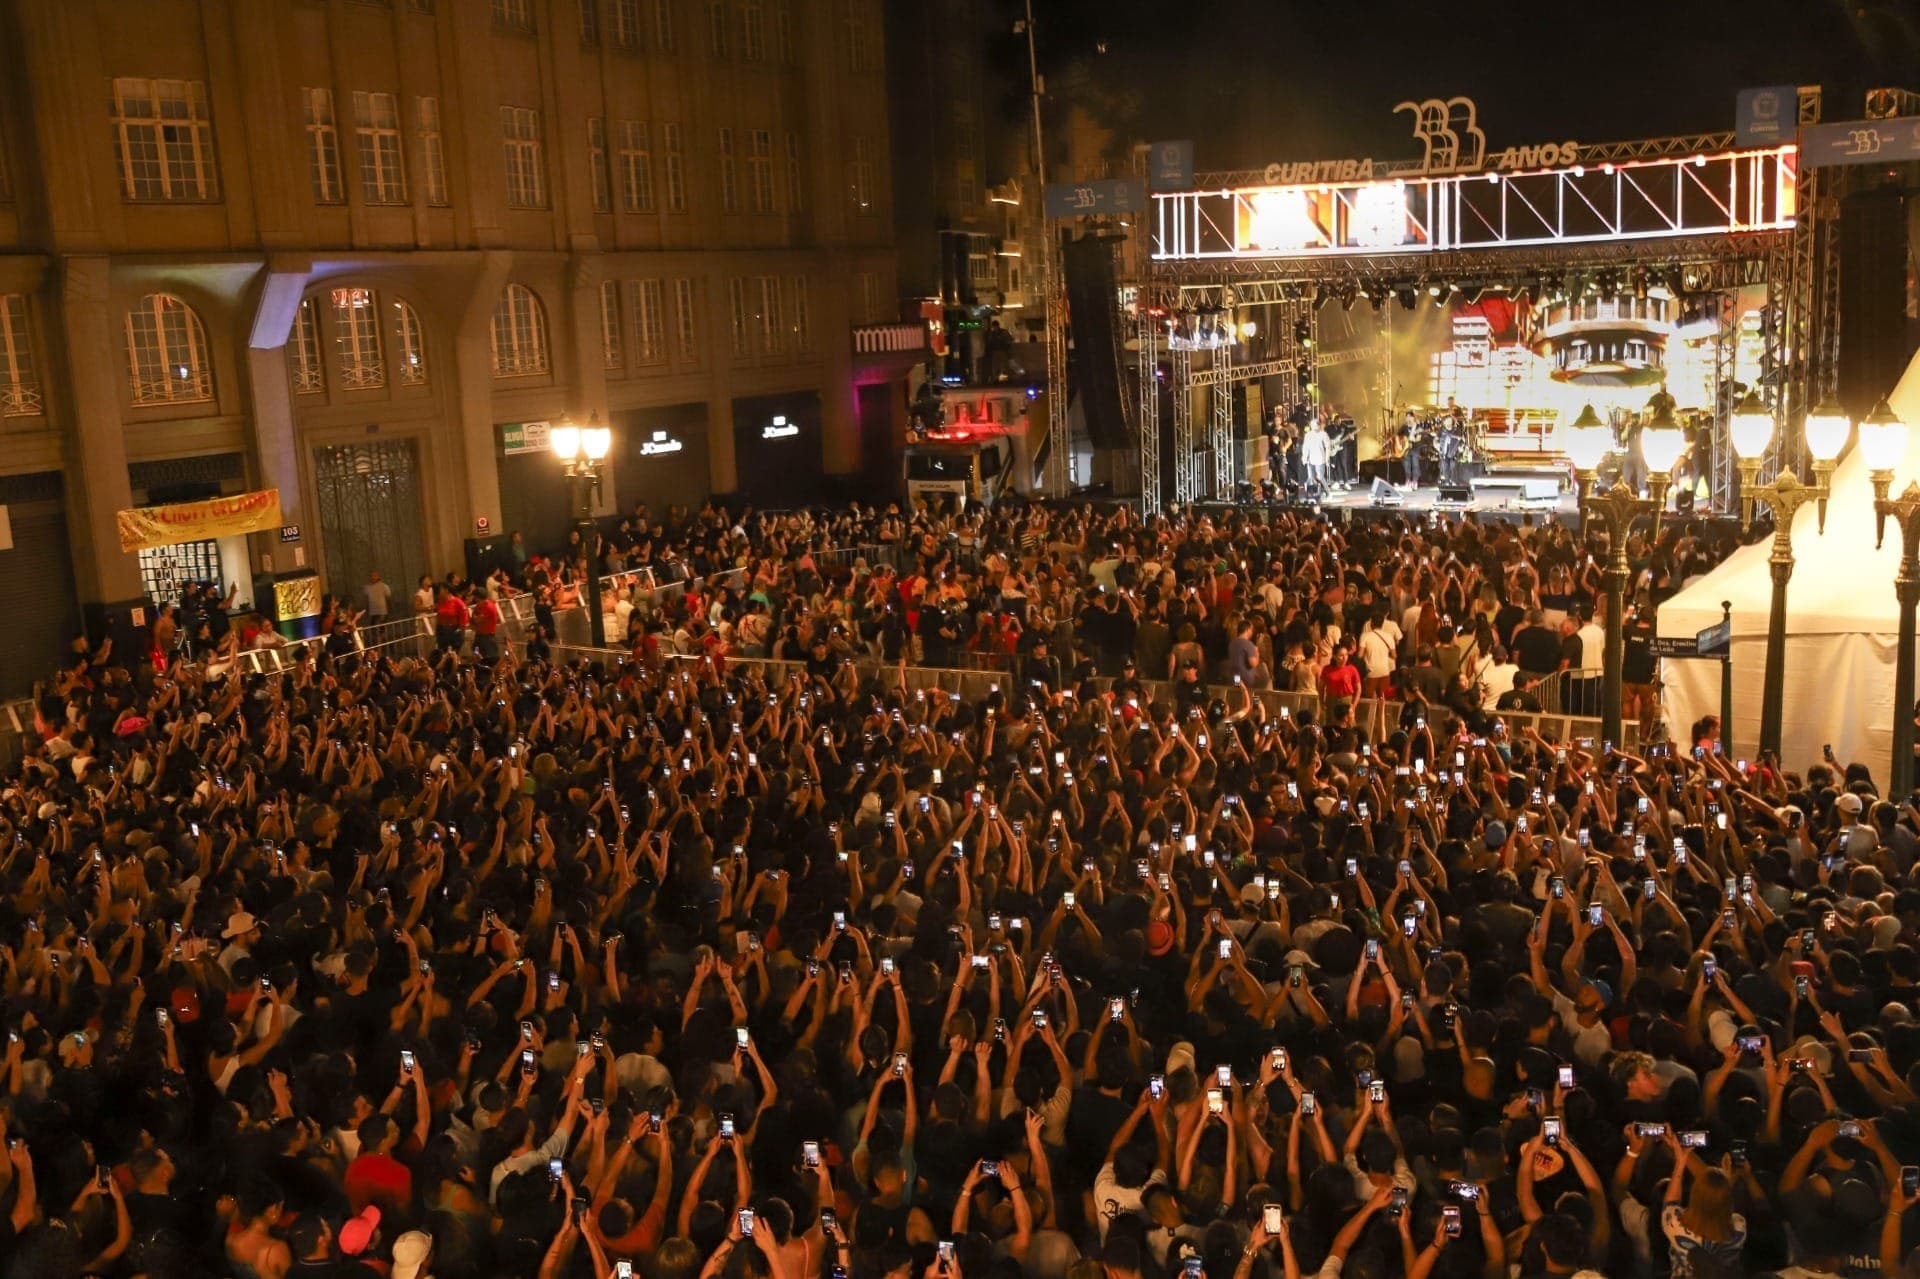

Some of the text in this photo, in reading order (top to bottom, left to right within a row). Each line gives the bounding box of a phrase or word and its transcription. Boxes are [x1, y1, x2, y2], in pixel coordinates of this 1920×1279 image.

[1264, 96, 1579, 185] CURITIBA 333 ANOS
[282, 526, 298, 537] 103
